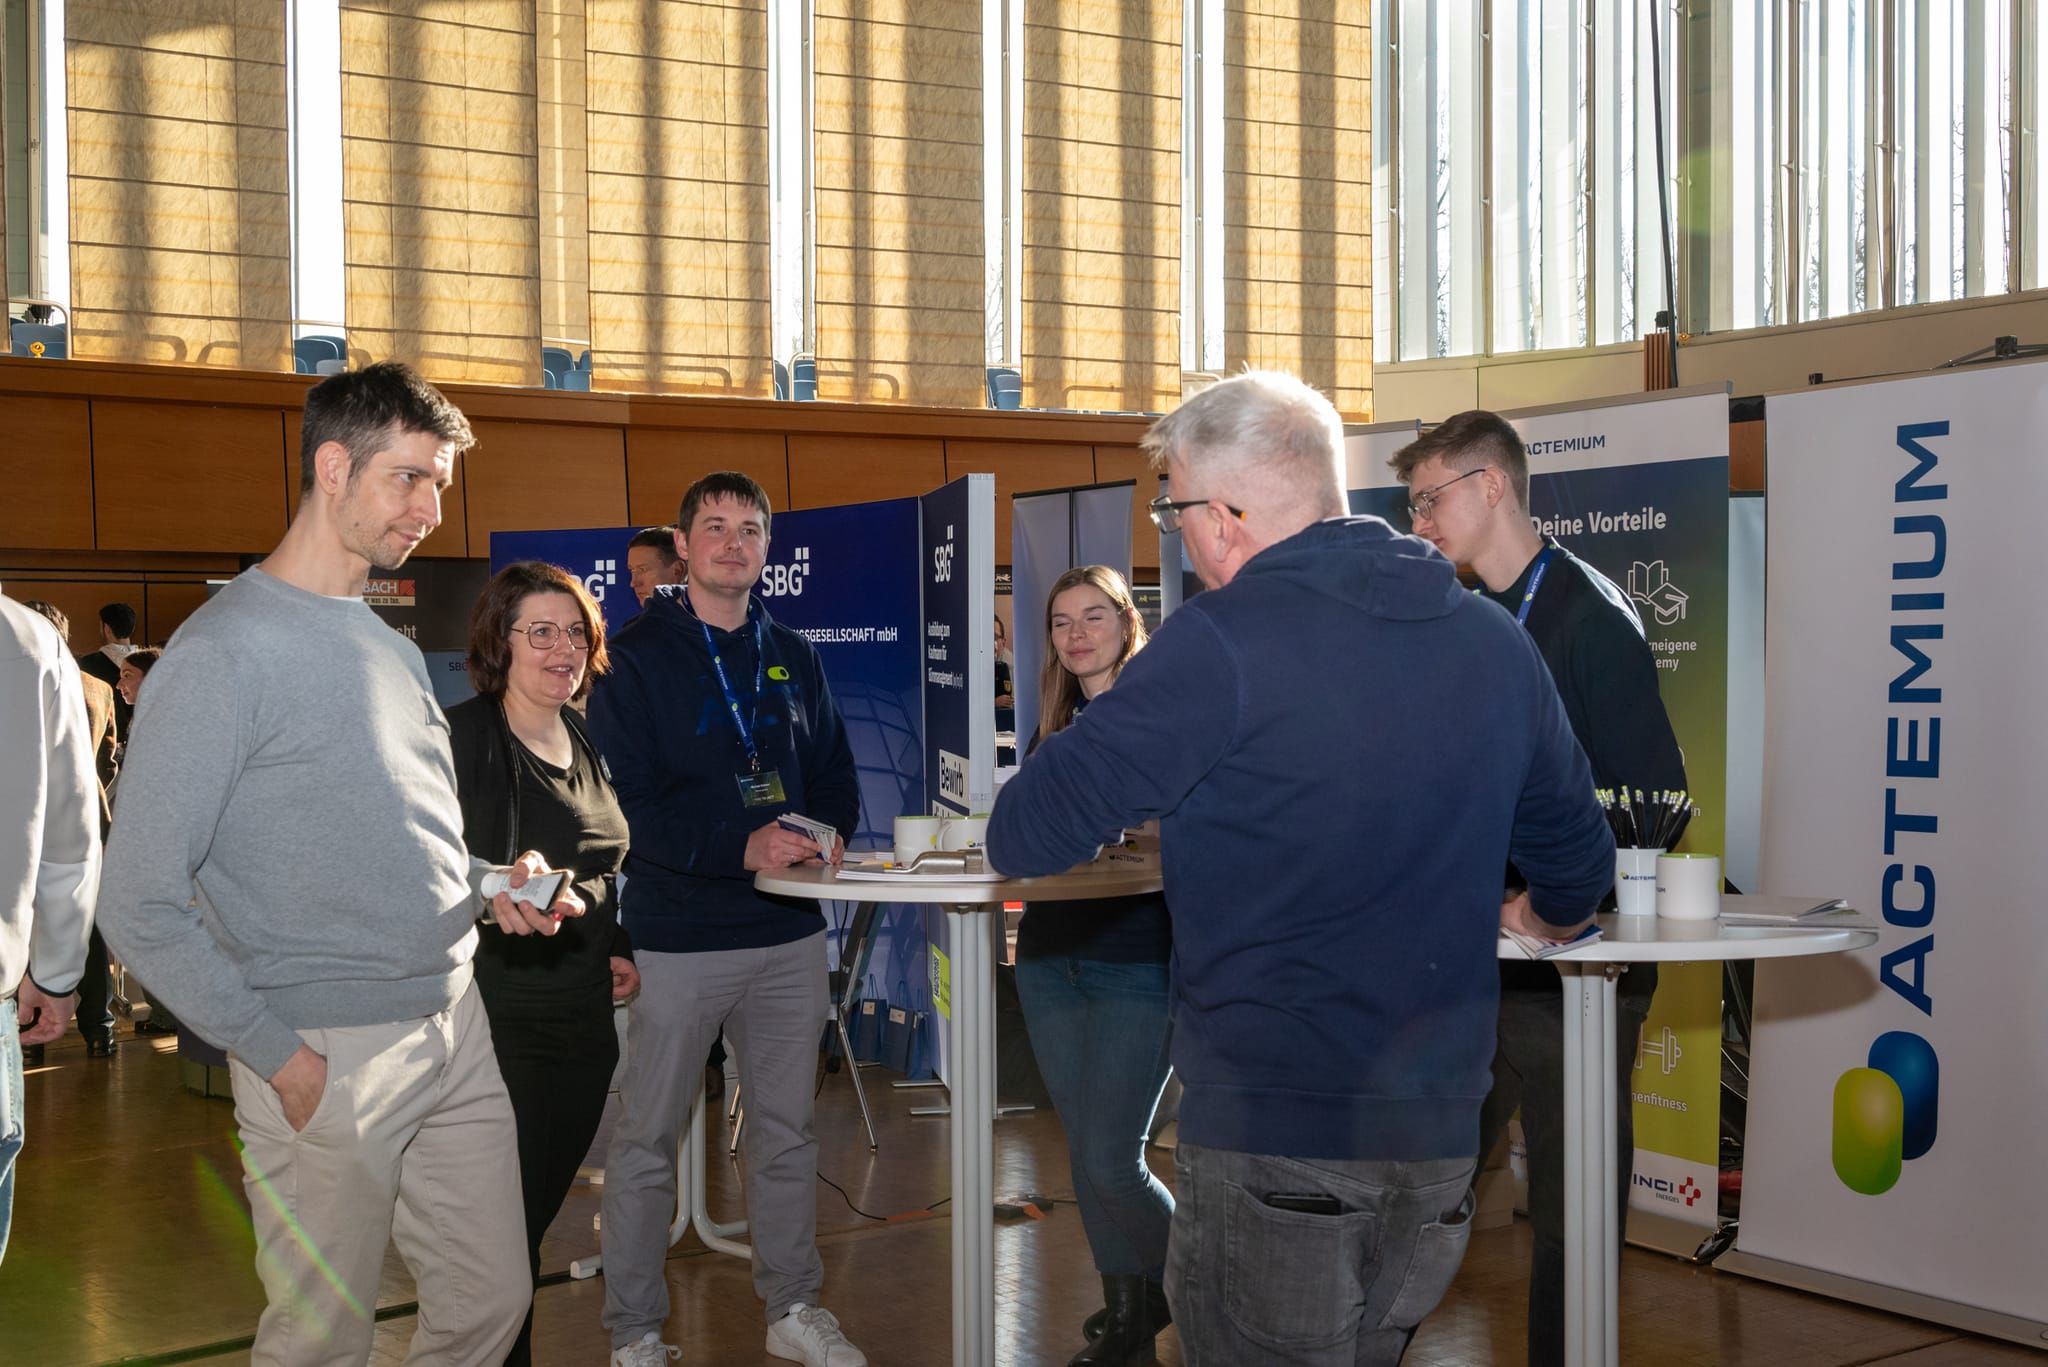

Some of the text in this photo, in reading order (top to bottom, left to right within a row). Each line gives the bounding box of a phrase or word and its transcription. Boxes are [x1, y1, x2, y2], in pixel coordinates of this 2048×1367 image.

[1530, 506, 1667, 537] Deine Vorteile
[935, 543, 951, 584] SBG
[362, 581, 398, 594] BACH
[761, 563, 803, 598] SBG
[793, 626, 898, 643] GSGESELLSCHAFT mbH
[1654, 658, 1680, 672] emy
[1879, 420, 1950, 1017] ACTEMIUM
[940, 755, 964, 799] Bewirb
[1633, 1173, 1674, 1194] INCI
